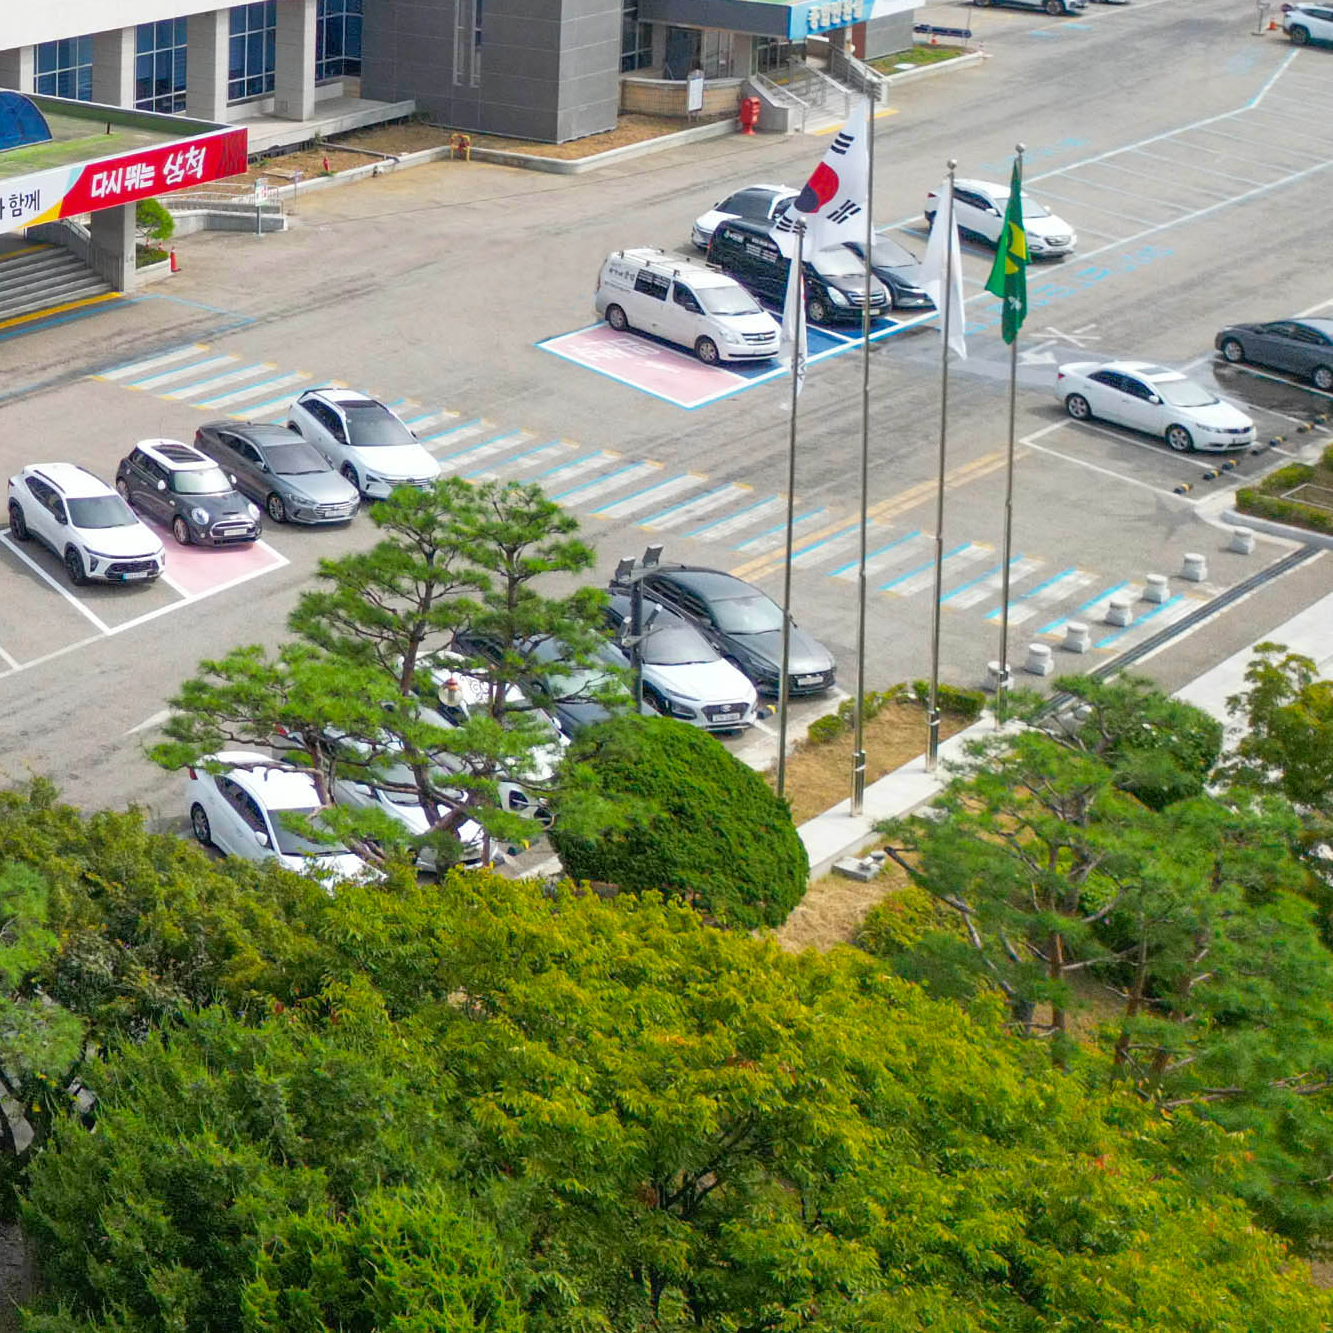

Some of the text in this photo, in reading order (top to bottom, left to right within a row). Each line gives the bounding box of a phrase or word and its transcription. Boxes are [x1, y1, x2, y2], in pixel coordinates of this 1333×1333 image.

[8, 189, 41, 218] 함께
[90, 166, 123, 199] 다시
[123, 162, 156, 192] 뛰는
[162, 145, 206, 185] 삼척
